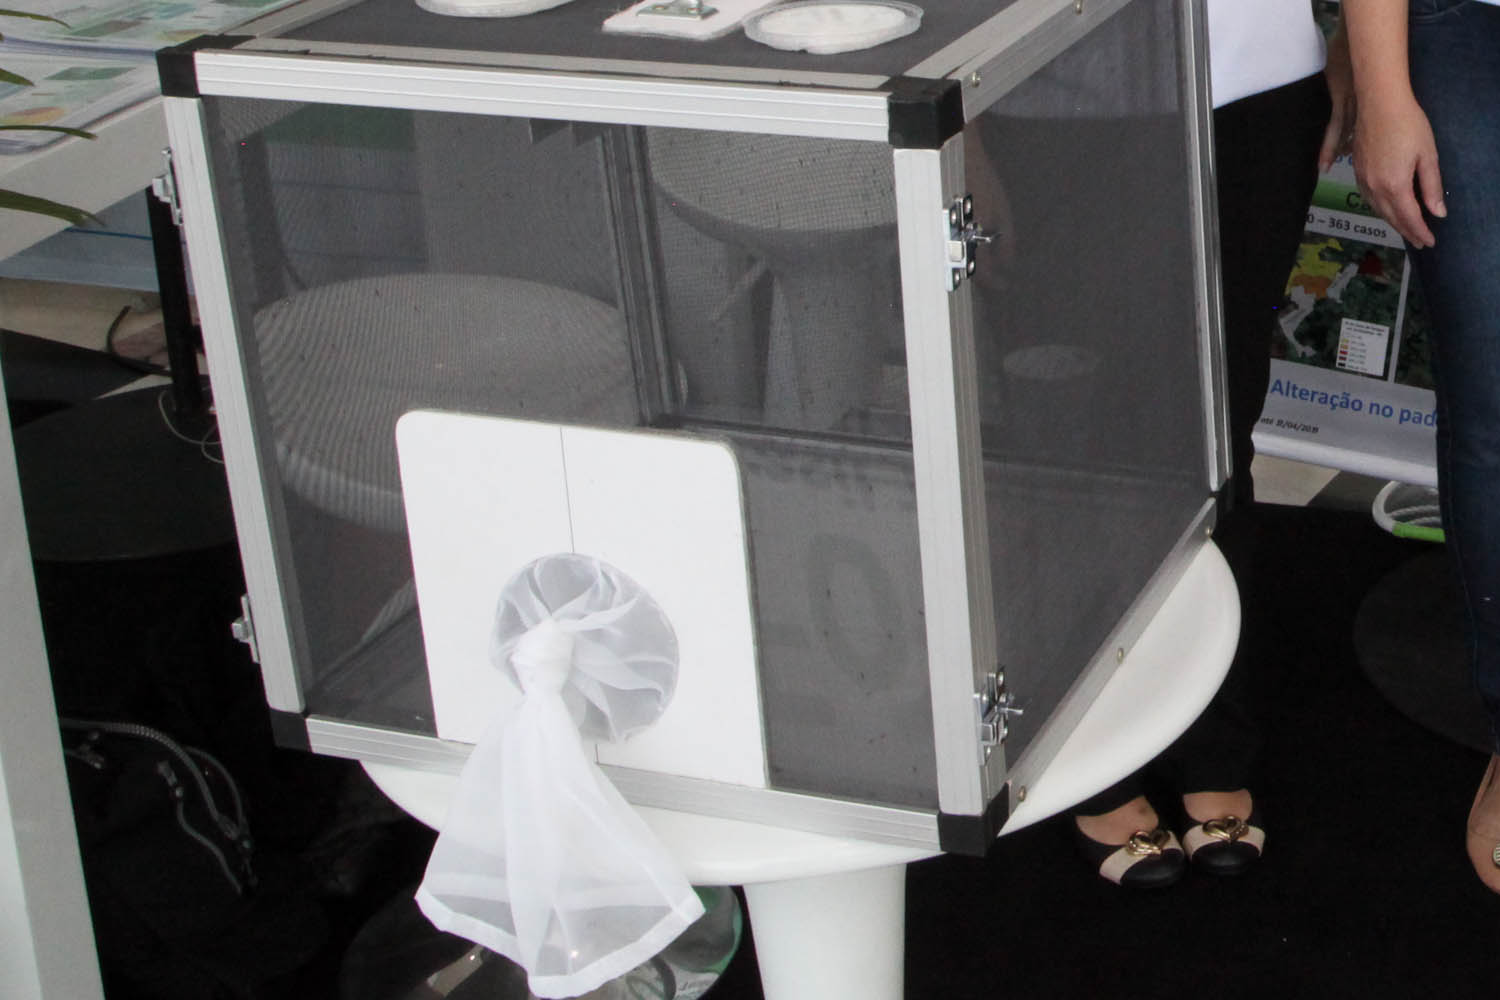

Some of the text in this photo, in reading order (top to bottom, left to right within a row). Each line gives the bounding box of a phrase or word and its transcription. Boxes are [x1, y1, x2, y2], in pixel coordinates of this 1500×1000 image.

[1328, 217, 1350, 231] 363
[1354, 225, 1387, 238] casos
[1270, 379, 1437, 427] Alteração no pad
